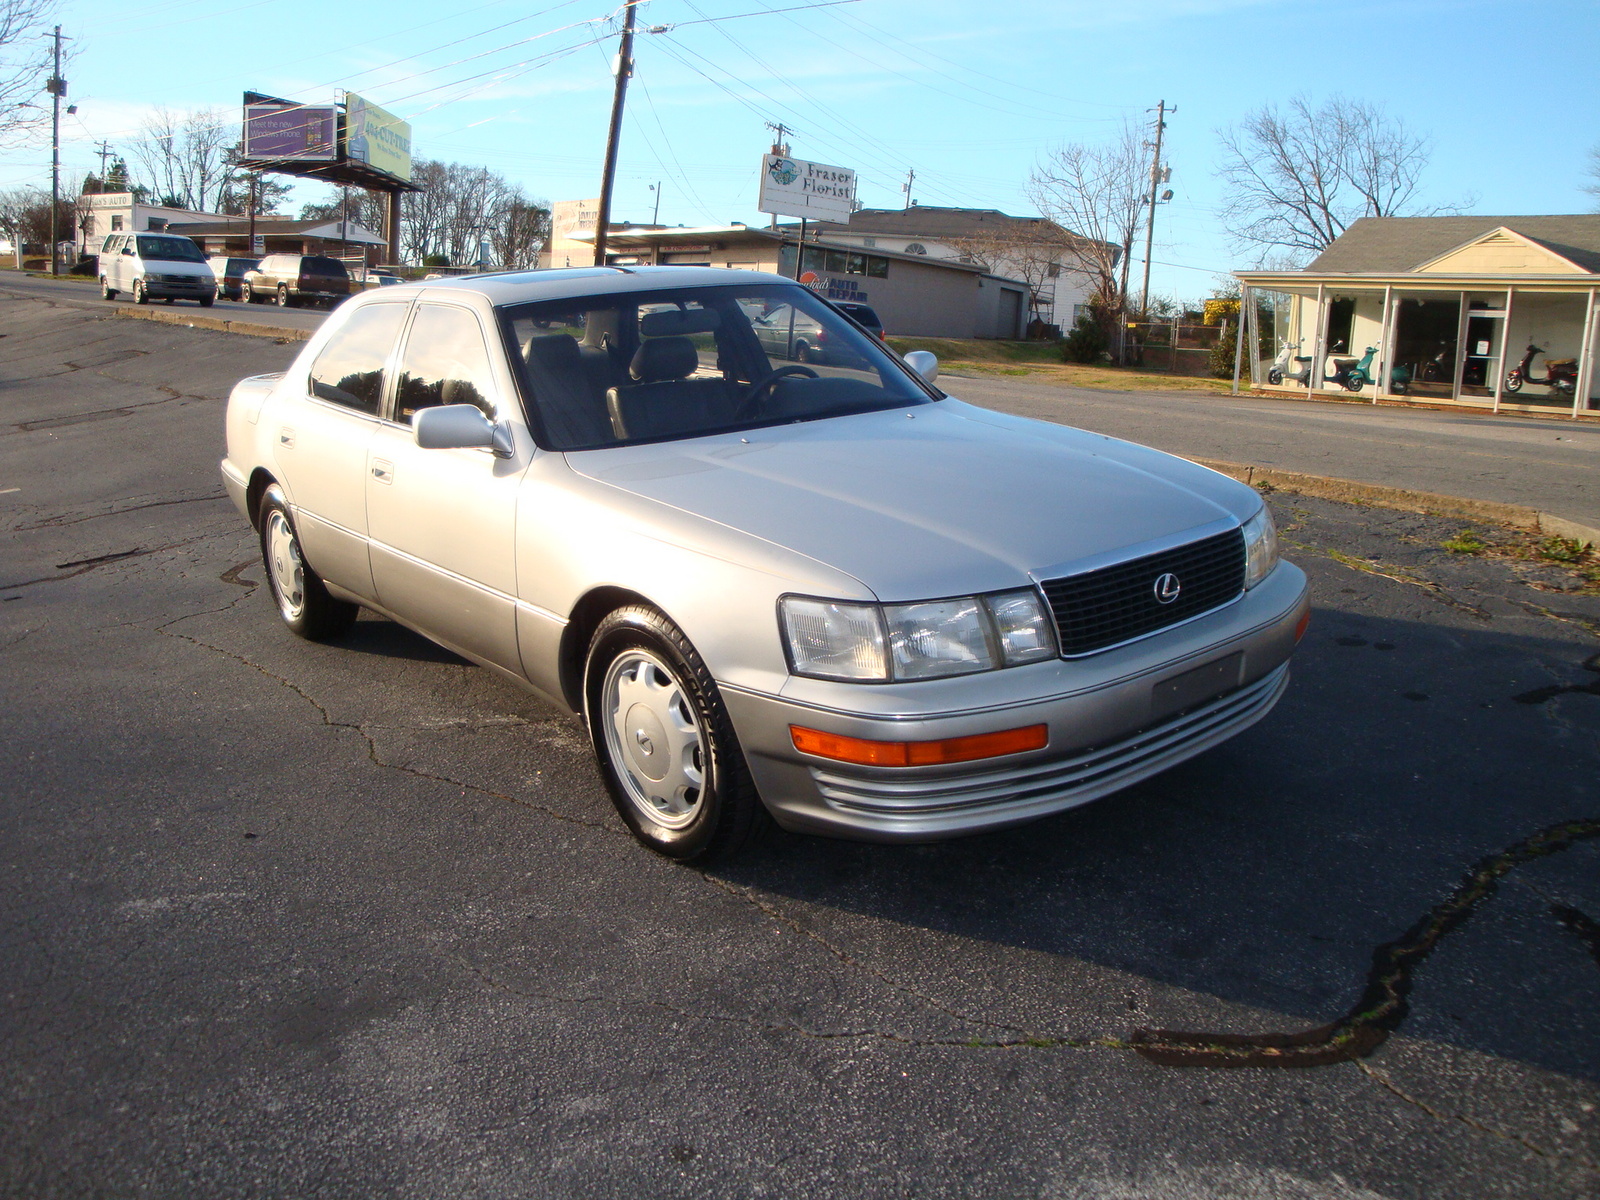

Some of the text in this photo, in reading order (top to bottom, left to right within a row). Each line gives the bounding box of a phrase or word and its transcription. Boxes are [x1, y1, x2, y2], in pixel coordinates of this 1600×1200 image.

[807, 163, 851, 183] Fraser
[802, 177, 850, 198] Florist
[829, 278, 859, 290] AUTO
[828, 288, 868, 302] REPAIR
